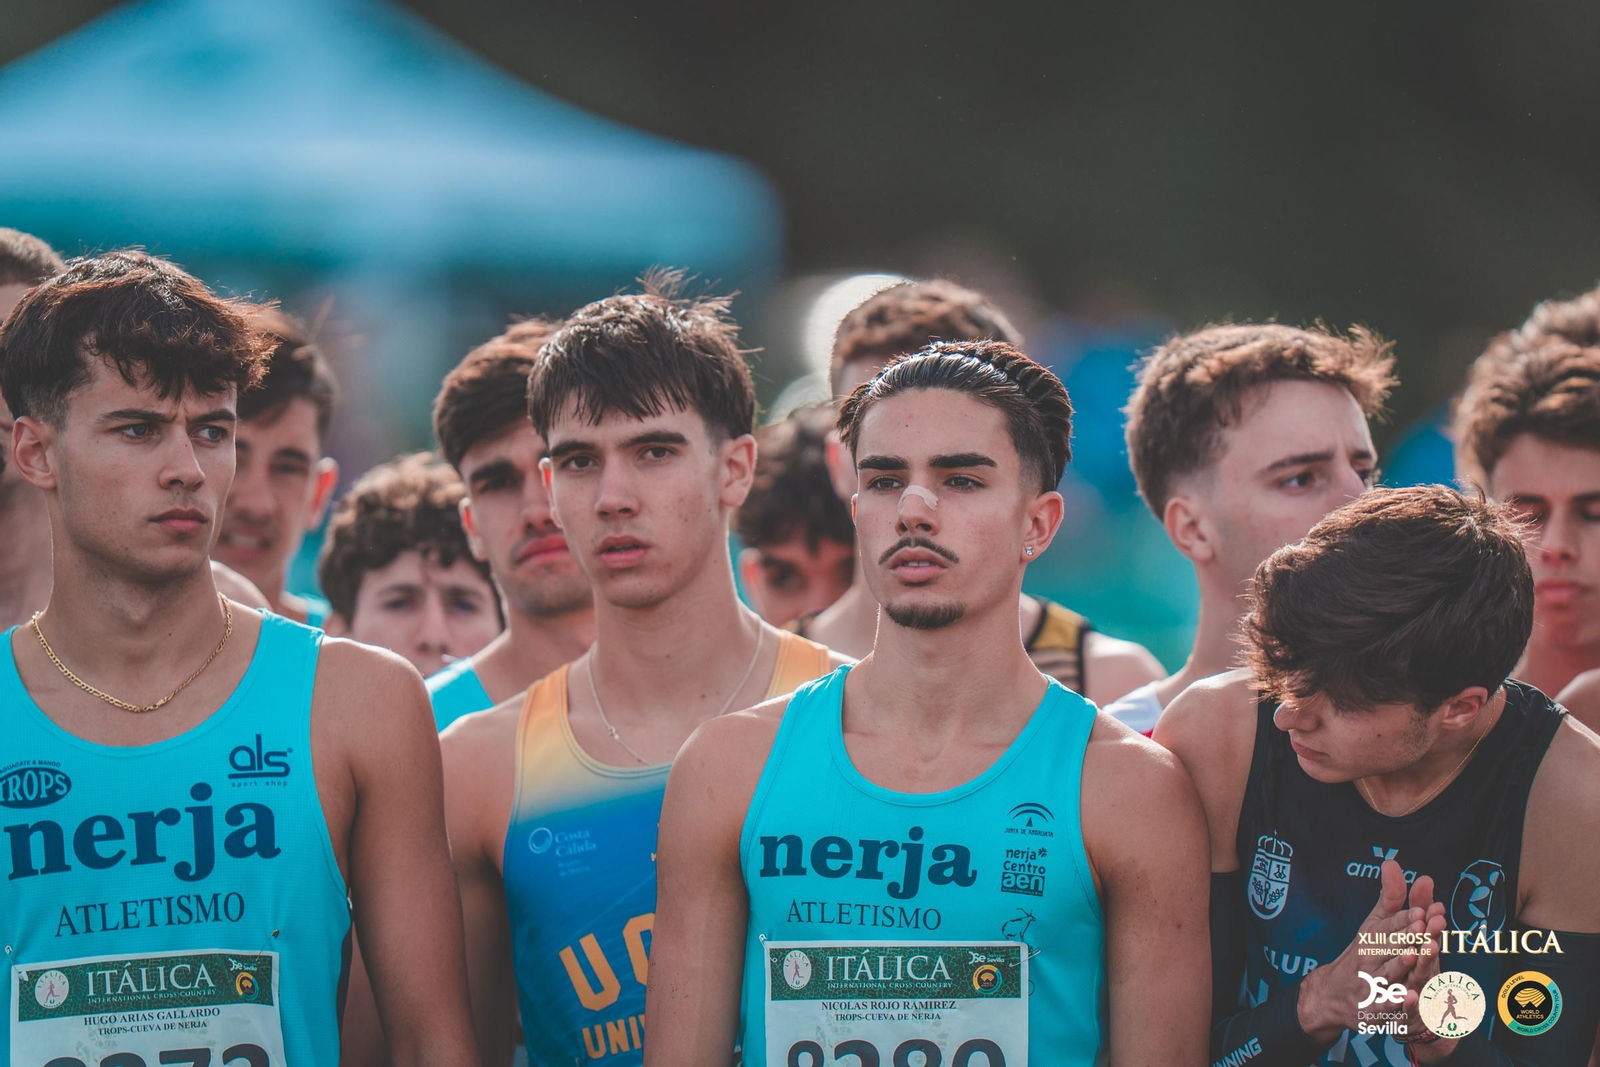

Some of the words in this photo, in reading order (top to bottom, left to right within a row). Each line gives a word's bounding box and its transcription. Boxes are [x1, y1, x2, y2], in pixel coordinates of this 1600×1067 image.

[38, 760, 61, 768] MANGO
[232, 780, 258, 788] sport
[3, 782, 281, 882] nerja
[759, 826, 978, 900] nerja
[1005, 847, 1037, 863] nerja
[1003, 860, 1046, 874] Centro
[1002, 873, 1044, 892] aen
[55, 891, 245, 938] ATLETISMO
[786, 899, 942, 931] ATLETISMO
[826, 948, 952, 981] ITÁLICA
[87, 962, 216, 997] ITÁLICA
[88, 993, 150, 1004] INTERNATIONAL
[153, 991, 177, 999] CROSS
[180, 989, 217, 997] COUNTRY
[821, 1001, 868, 1011] NICOLAS
[870, 1001, 900, 1010] ROJO
[903, 1000, 957, 1010] RAMIREZ
[84, 1014, 117, 1026] HUGO
[120, 1011, 154, 1023] ARIAS
[157, 1007, 221, 1020] GALLARDO
[835, 1013, 895, 1021] TROPS-CUEVA
[912, 1012, 941, 1020] NERJA
[98, 1023, 161, 1036] TROPS-CUEVA
[164, 1022, 176, 1031] DE
[178, 1020, 208, 1030] NERJA
